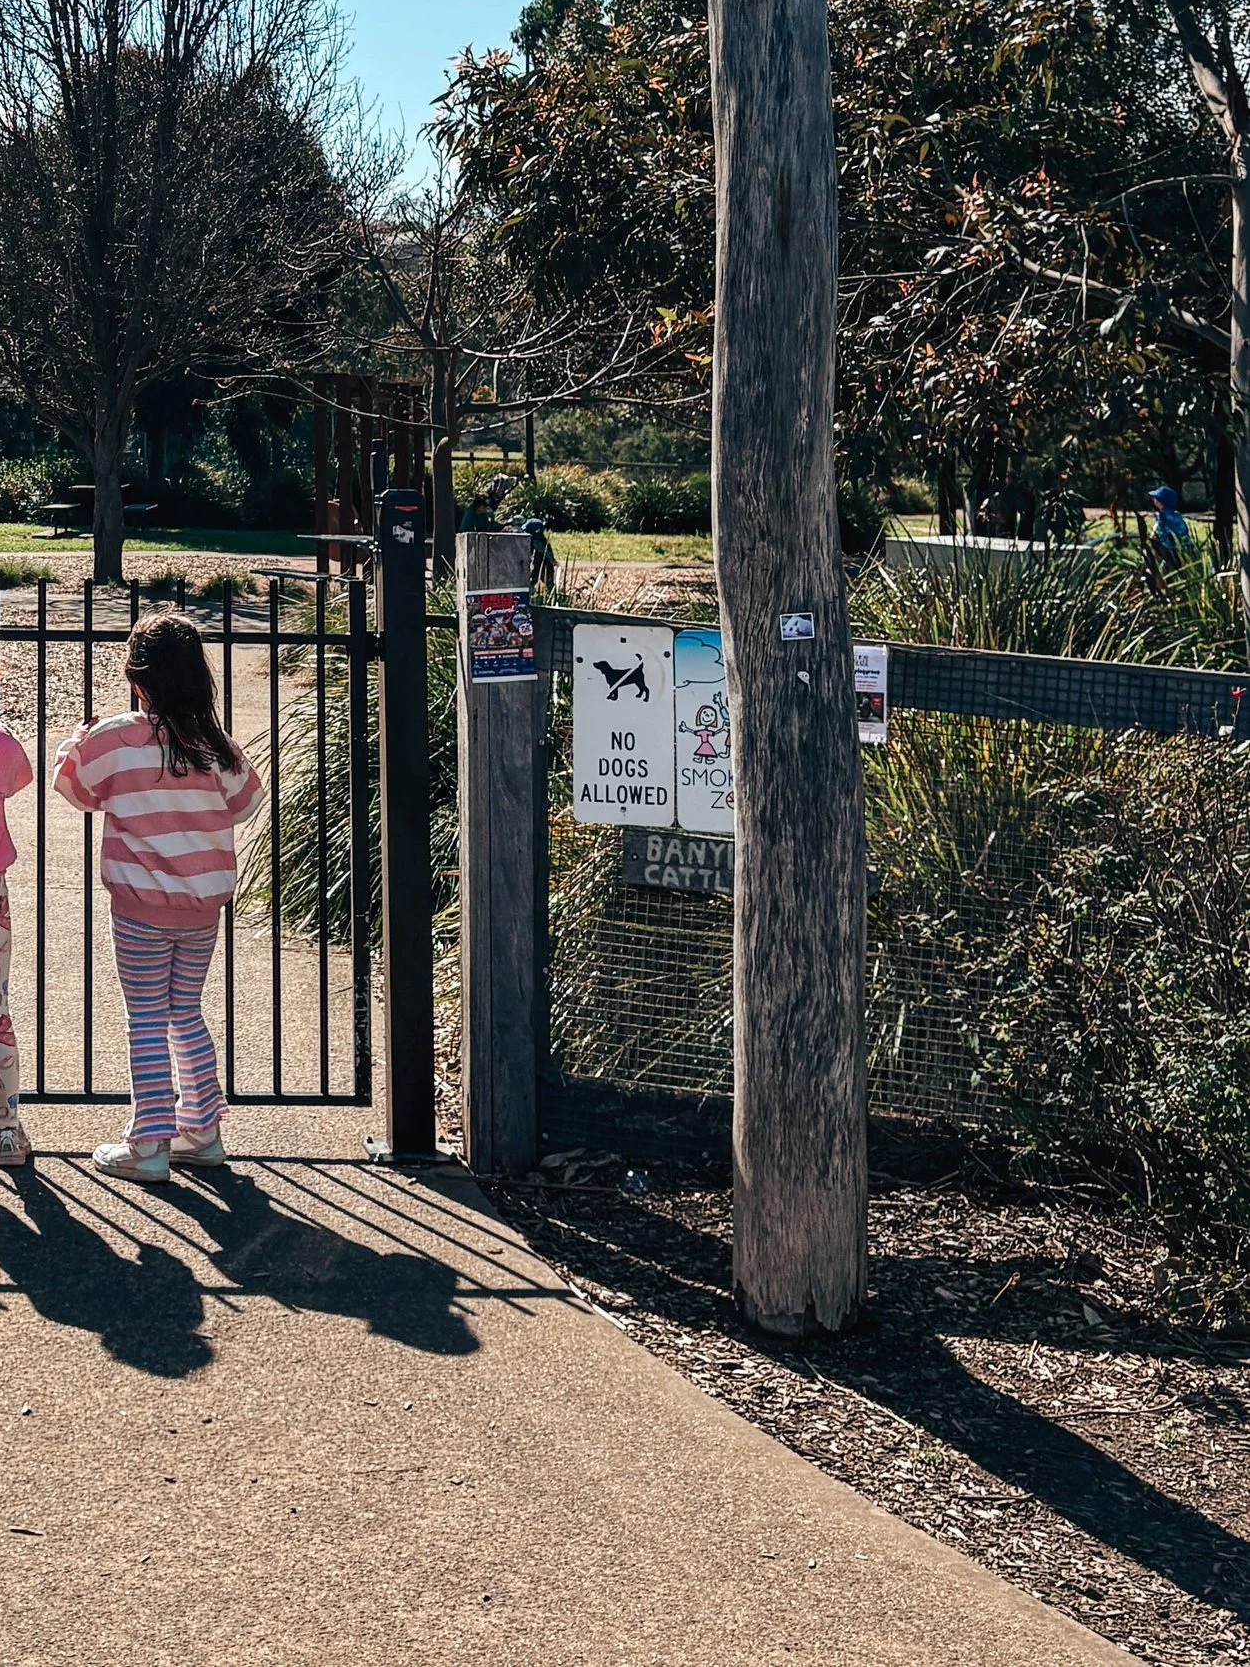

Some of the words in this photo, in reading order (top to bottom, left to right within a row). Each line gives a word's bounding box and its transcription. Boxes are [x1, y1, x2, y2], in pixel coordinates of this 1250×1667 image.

[611, 731, 636, 751] NO
[599, 758, 648, 778] DOGS
[580, 784, 668, 806] ALLOWED
[644, 864, 731, 893] CATTL
